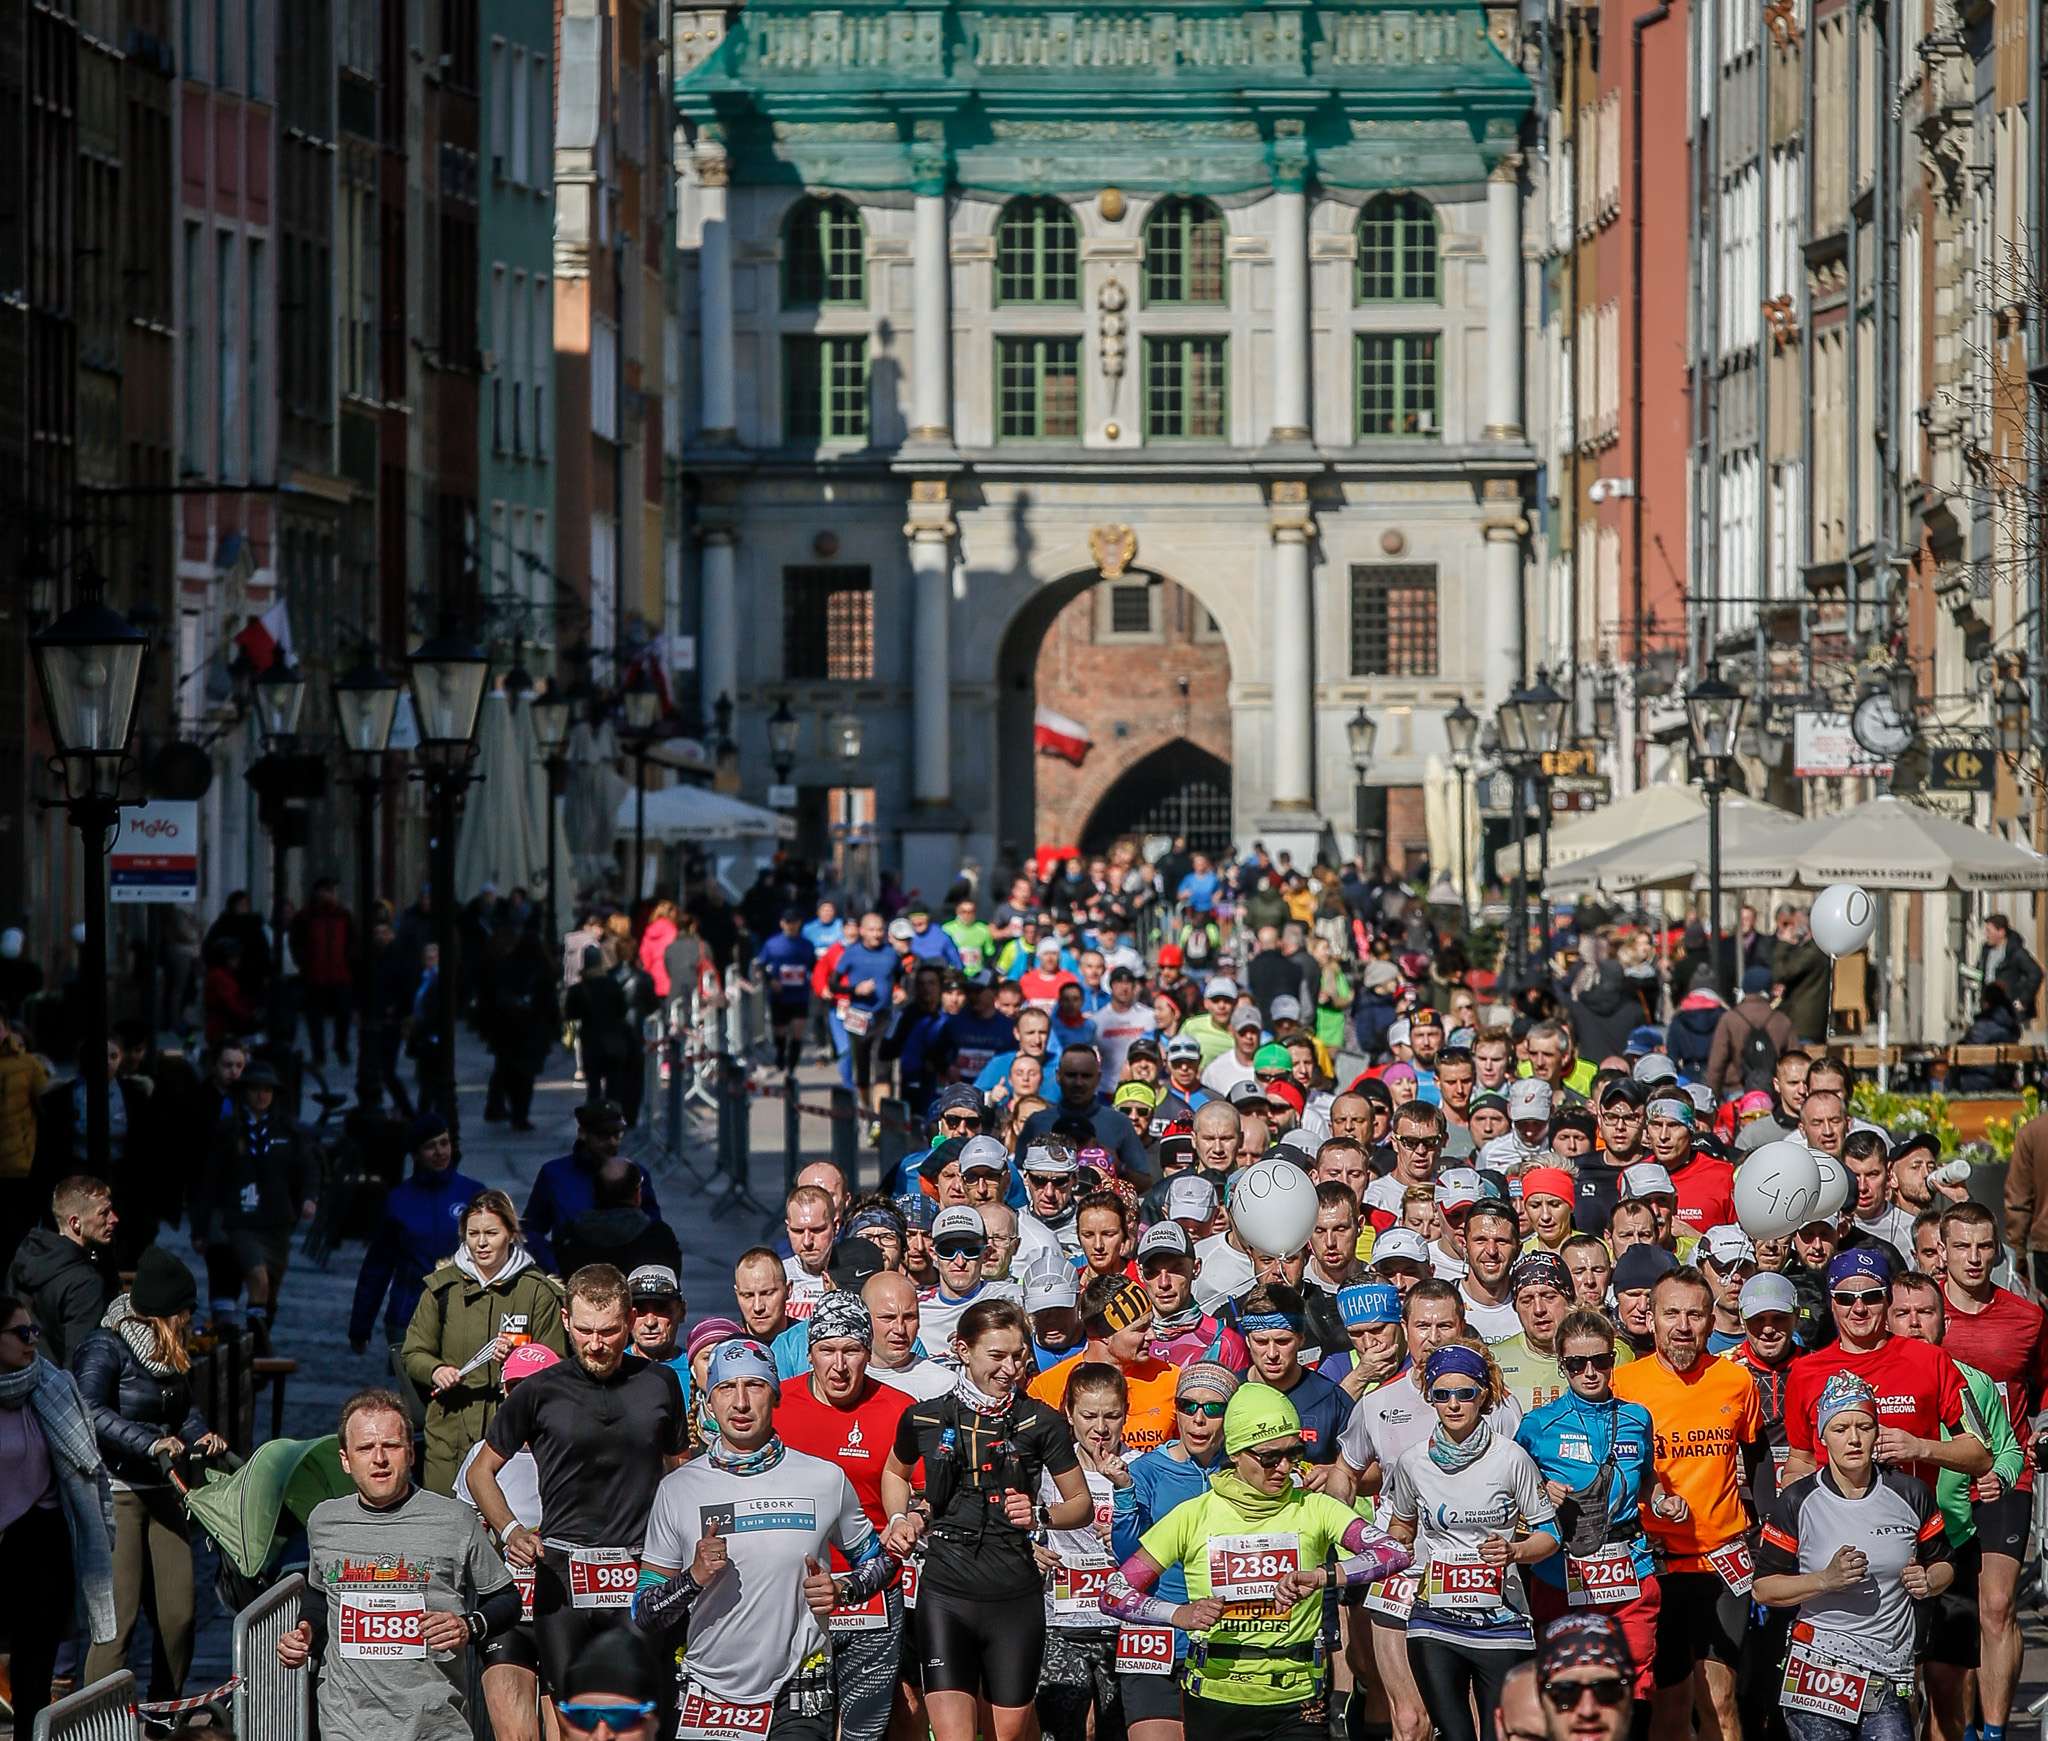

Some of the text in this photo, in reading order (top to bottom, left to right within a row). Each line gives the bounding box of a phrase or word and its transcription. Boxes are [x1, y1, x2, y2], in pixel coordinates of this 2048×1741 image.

[1347, 1293, 1388, 1317] HAPPY
[1881, 1405, 1916, 1414] BIEGOWA
[1671, 1431, 1684, 1443] 5.
[1617, 1445, 1638, 1455] JYSK
[749, 1500, 795, 1512] LĘBORK
[742, 1517, 815, 1528] SWIM BIKE RUN
[1449, 1511, 1464, 1524] 2.
[1465, 1515, 1501, 1524] MARATON
[1231, 1555, 1294, 1580] 2384
[1585, 1562, 1634, 1585] 2264
[596, 1567, 638, 1588] 989
[1448, 1567, 1496, 1589] 1352
[1236, 1585, 1275, 1597] RENATA
[1589, 1588, 1626, 1600] NATALIA
[595, 1594, 629, 1605] JANUSZ
[1451, 1594, 1479, 1605] KASIA
[359, 1615, 420, 1640] 1588
[829, 1617, 865, 1627] MARCIN
[1220, 1618, 1290, 1633] runners
[1120, 1633, 1167, 1656] 1195
[359, 1645, 403, 1657] DARIUSZ
[1804, 1670, 1859, 1701] 1094
[1790, 1694, 1847, 1717] MAGDALENA
[705, 1706, 763, 1728] 2182
[703, 1729, 741, 1740] MAREK
